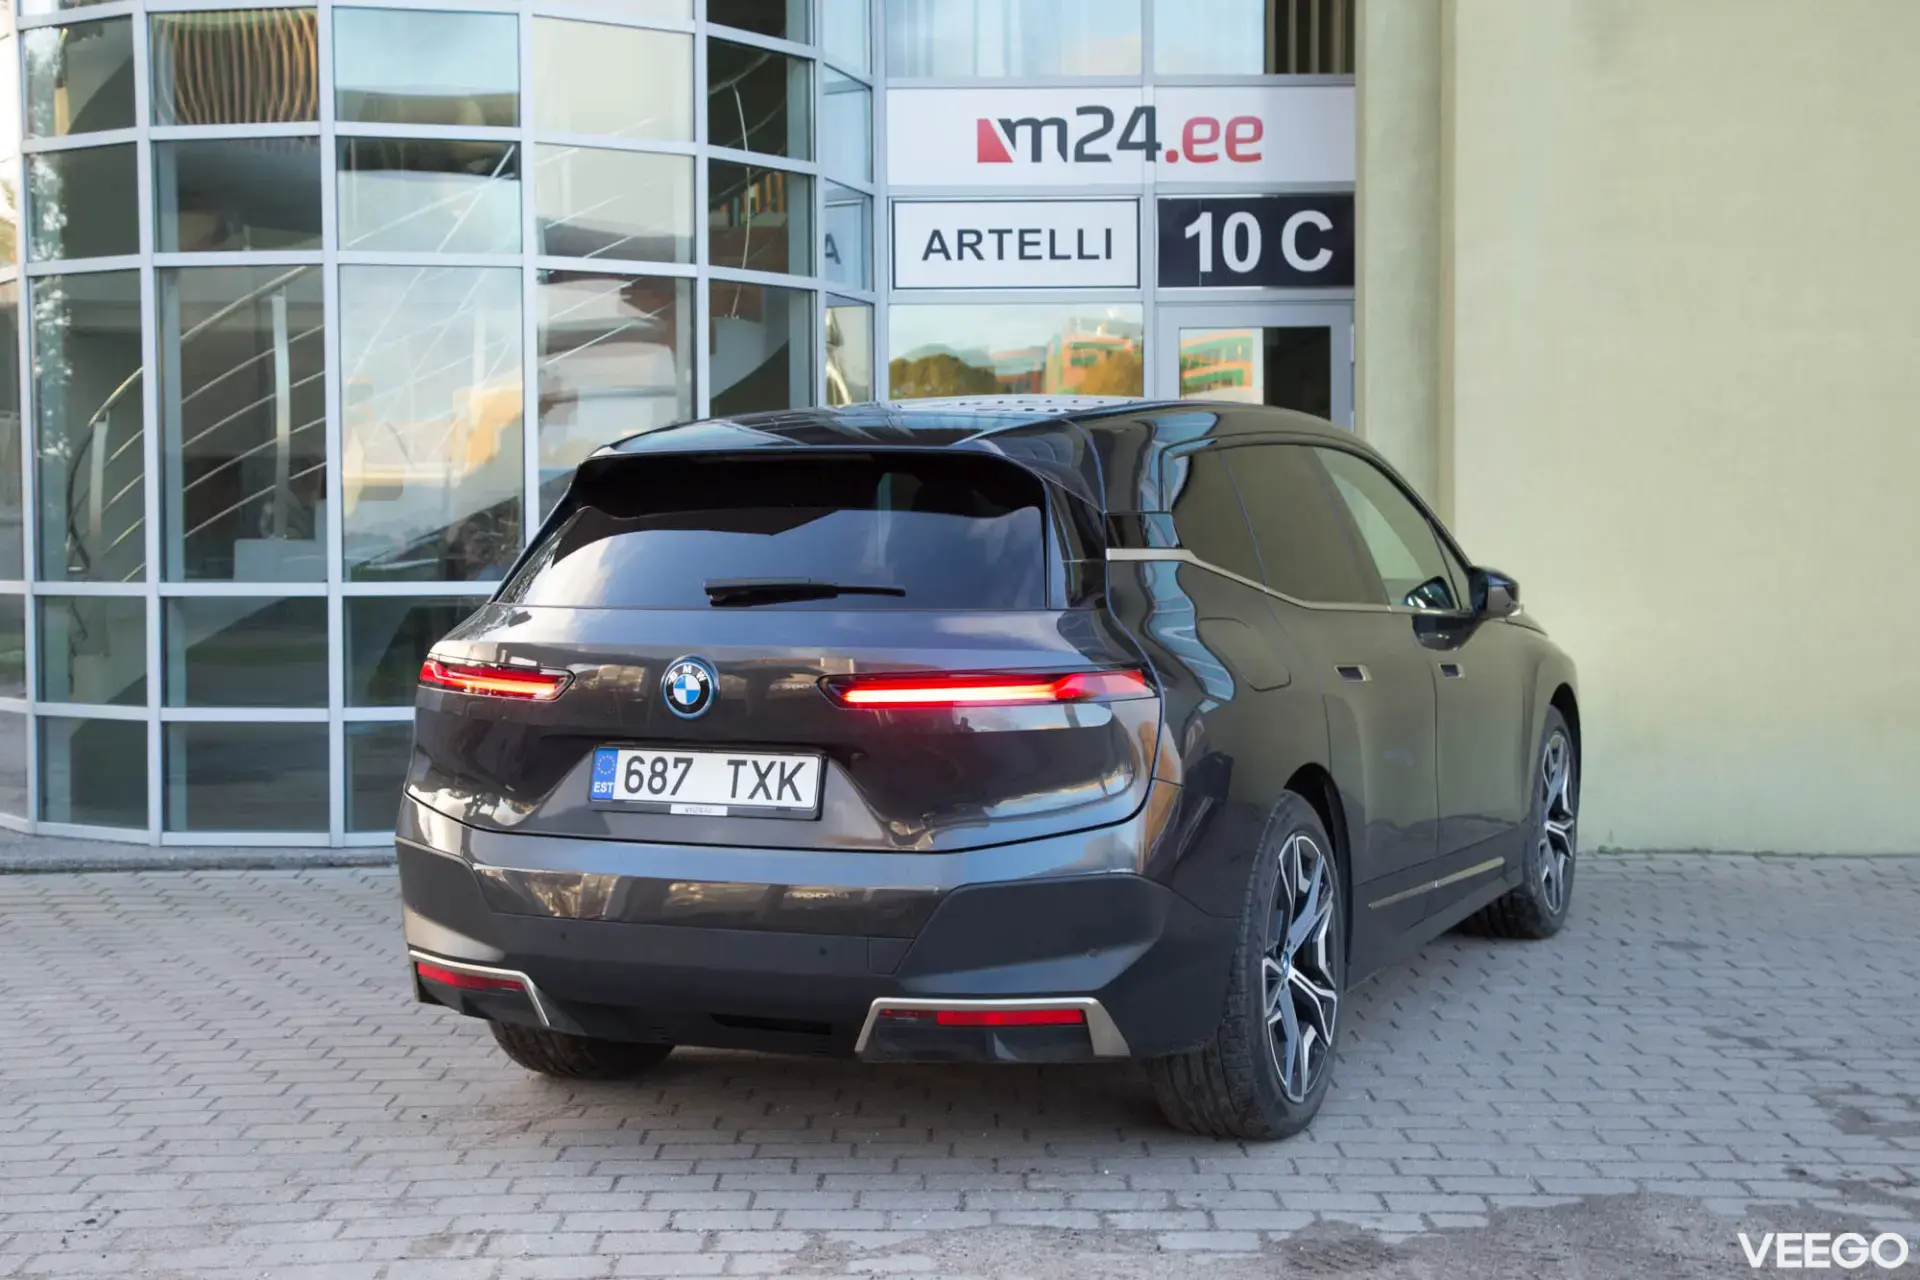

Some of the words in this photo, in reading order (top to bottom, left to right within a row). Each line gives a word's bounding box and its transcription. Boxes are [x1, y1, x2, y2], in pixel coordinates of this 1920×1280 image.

[998, 105, 1263, 163] m24.ee
[922, 228, 1112, 260] ARTELLI
[1184, 212, 1262, 272] 10
[1281, 210, 1334, 272] C
[668, 664, 707, 685] BMW
[593, 782, 613, 793] EST
[624, 755, 694, 796] 687
[727, 759, 806, 802] TXK
